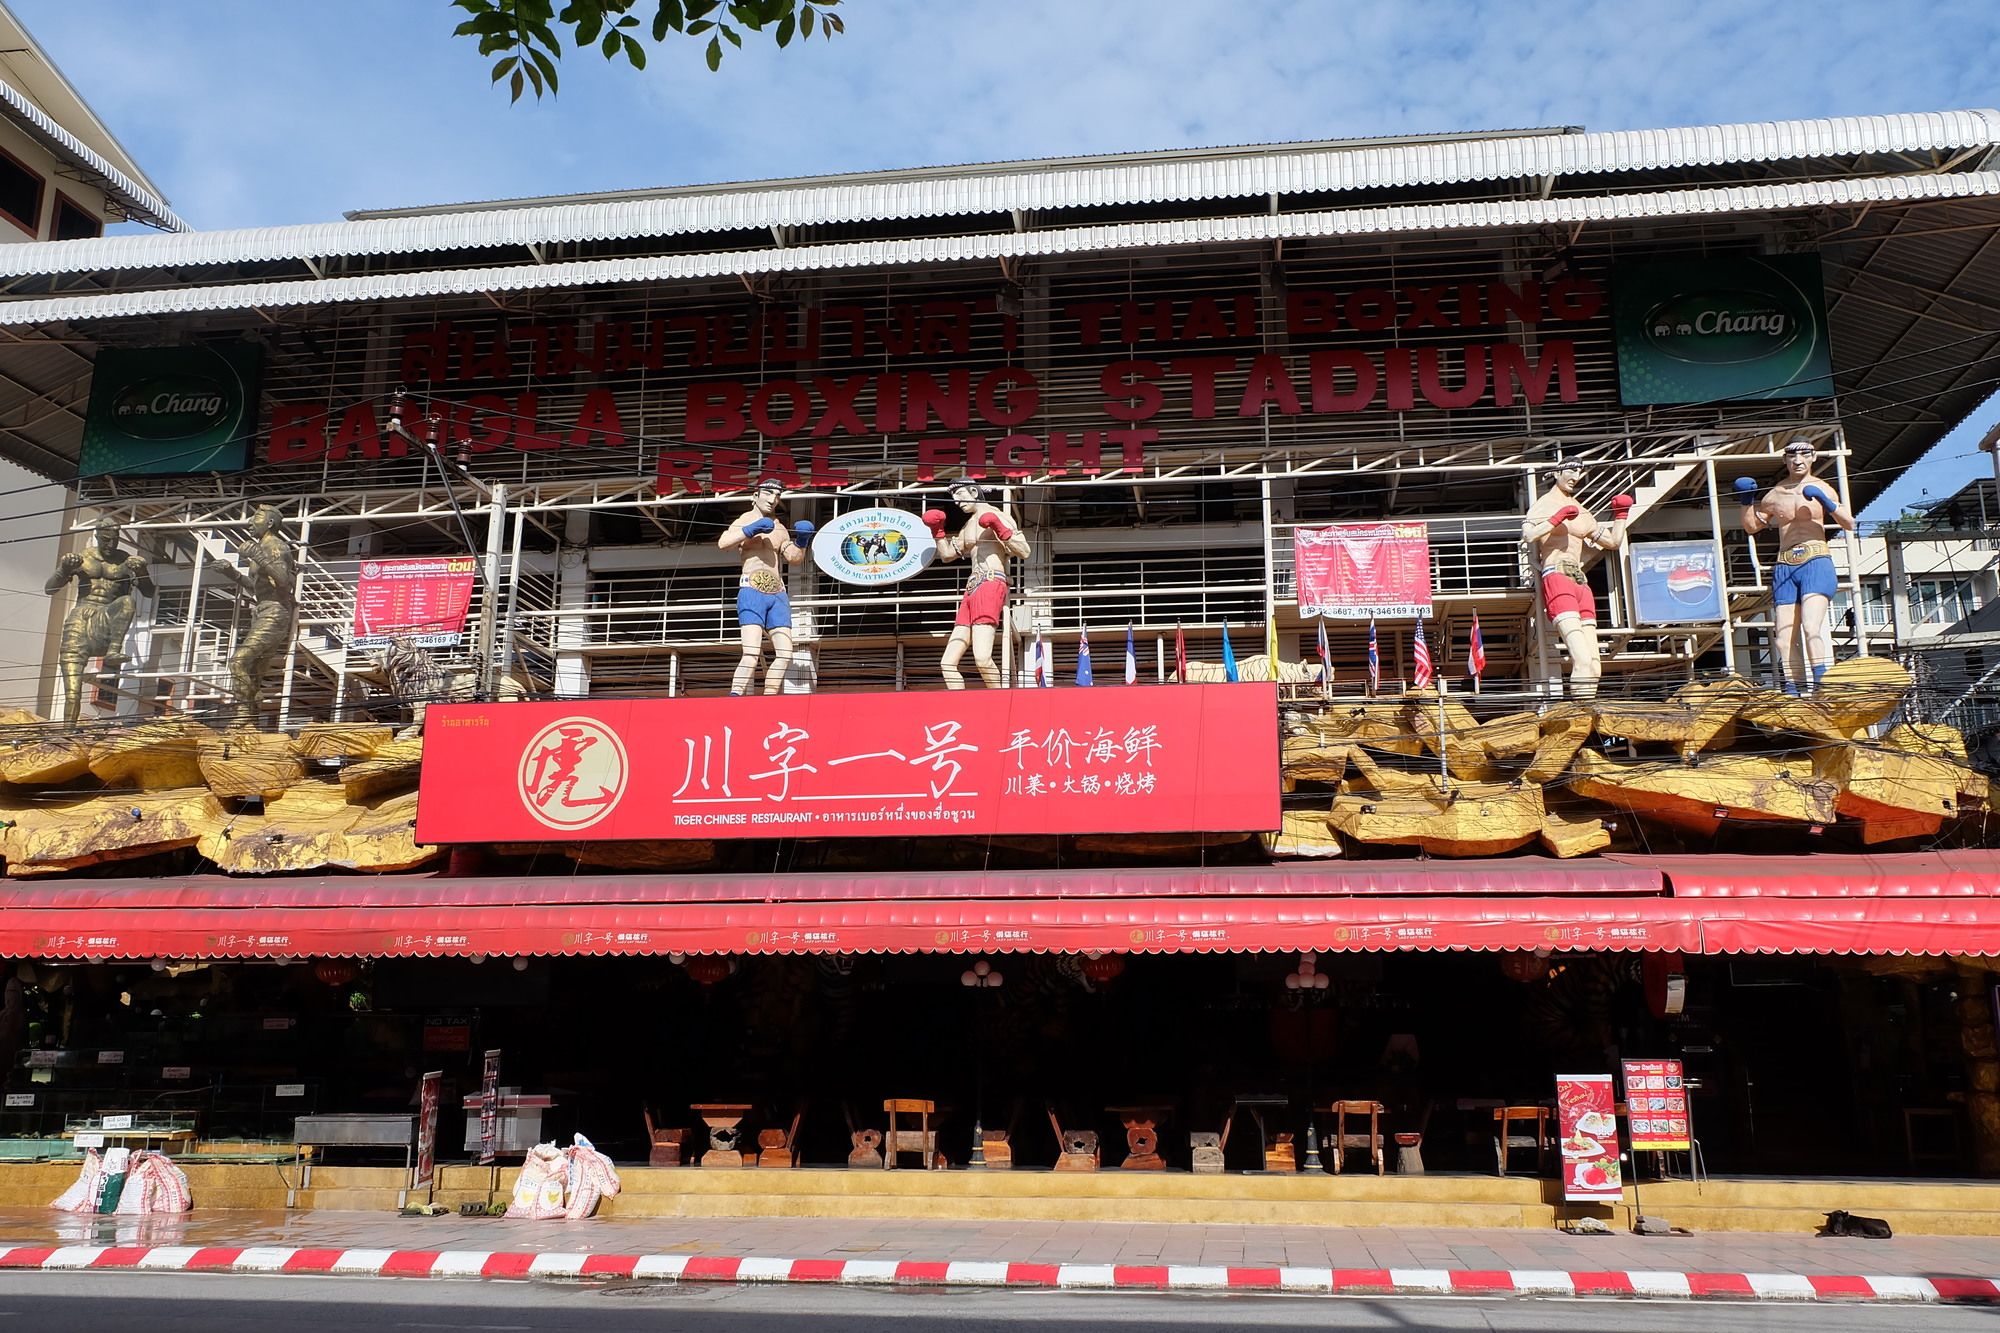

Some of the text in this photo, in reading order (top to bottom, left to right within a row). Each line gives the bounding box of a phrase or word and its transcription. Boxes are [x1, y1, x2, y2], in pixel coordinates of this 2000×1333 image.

[1065, 275, 1604, 346] THAI BOXING
[1695, 311, 1785, 335] Chang
[151, 393, 223, 416] Chang
[267, 338, 1579, 463] BANGLA BOXING STADIUM
[656, 428, 1159, 495] REAL FIGHT
[831, 555, 851, 576] WORLD
[893, 553, 921, 576] COUNCIL
[1637, 553, 1714, 573] PEPSI
[998, 725, 1162, 769] 平价海鲜
[672, 721, 978, 801] 川字一号
[674, 815, 702, 824] TIGER
[704, 814, 746, 824] CHINESE
[752, 813, 812, 823] RESTAURANT
[574, 932, 613, 944] 川字一号
[760, 931, 800, 944] 川字一号
[950, 930, 991, 943] 川字一号
[1145, 929, 1187, 942] 川字一号
[1350, 928, 1392, 941] 川字一号
[1561, 927, 1606, 940] 川字一号
[48, 936, 84, 948] 川字一号
[218, 935, 255, 947] 川字一号
[394, 935, 432, 947] 川字一号
